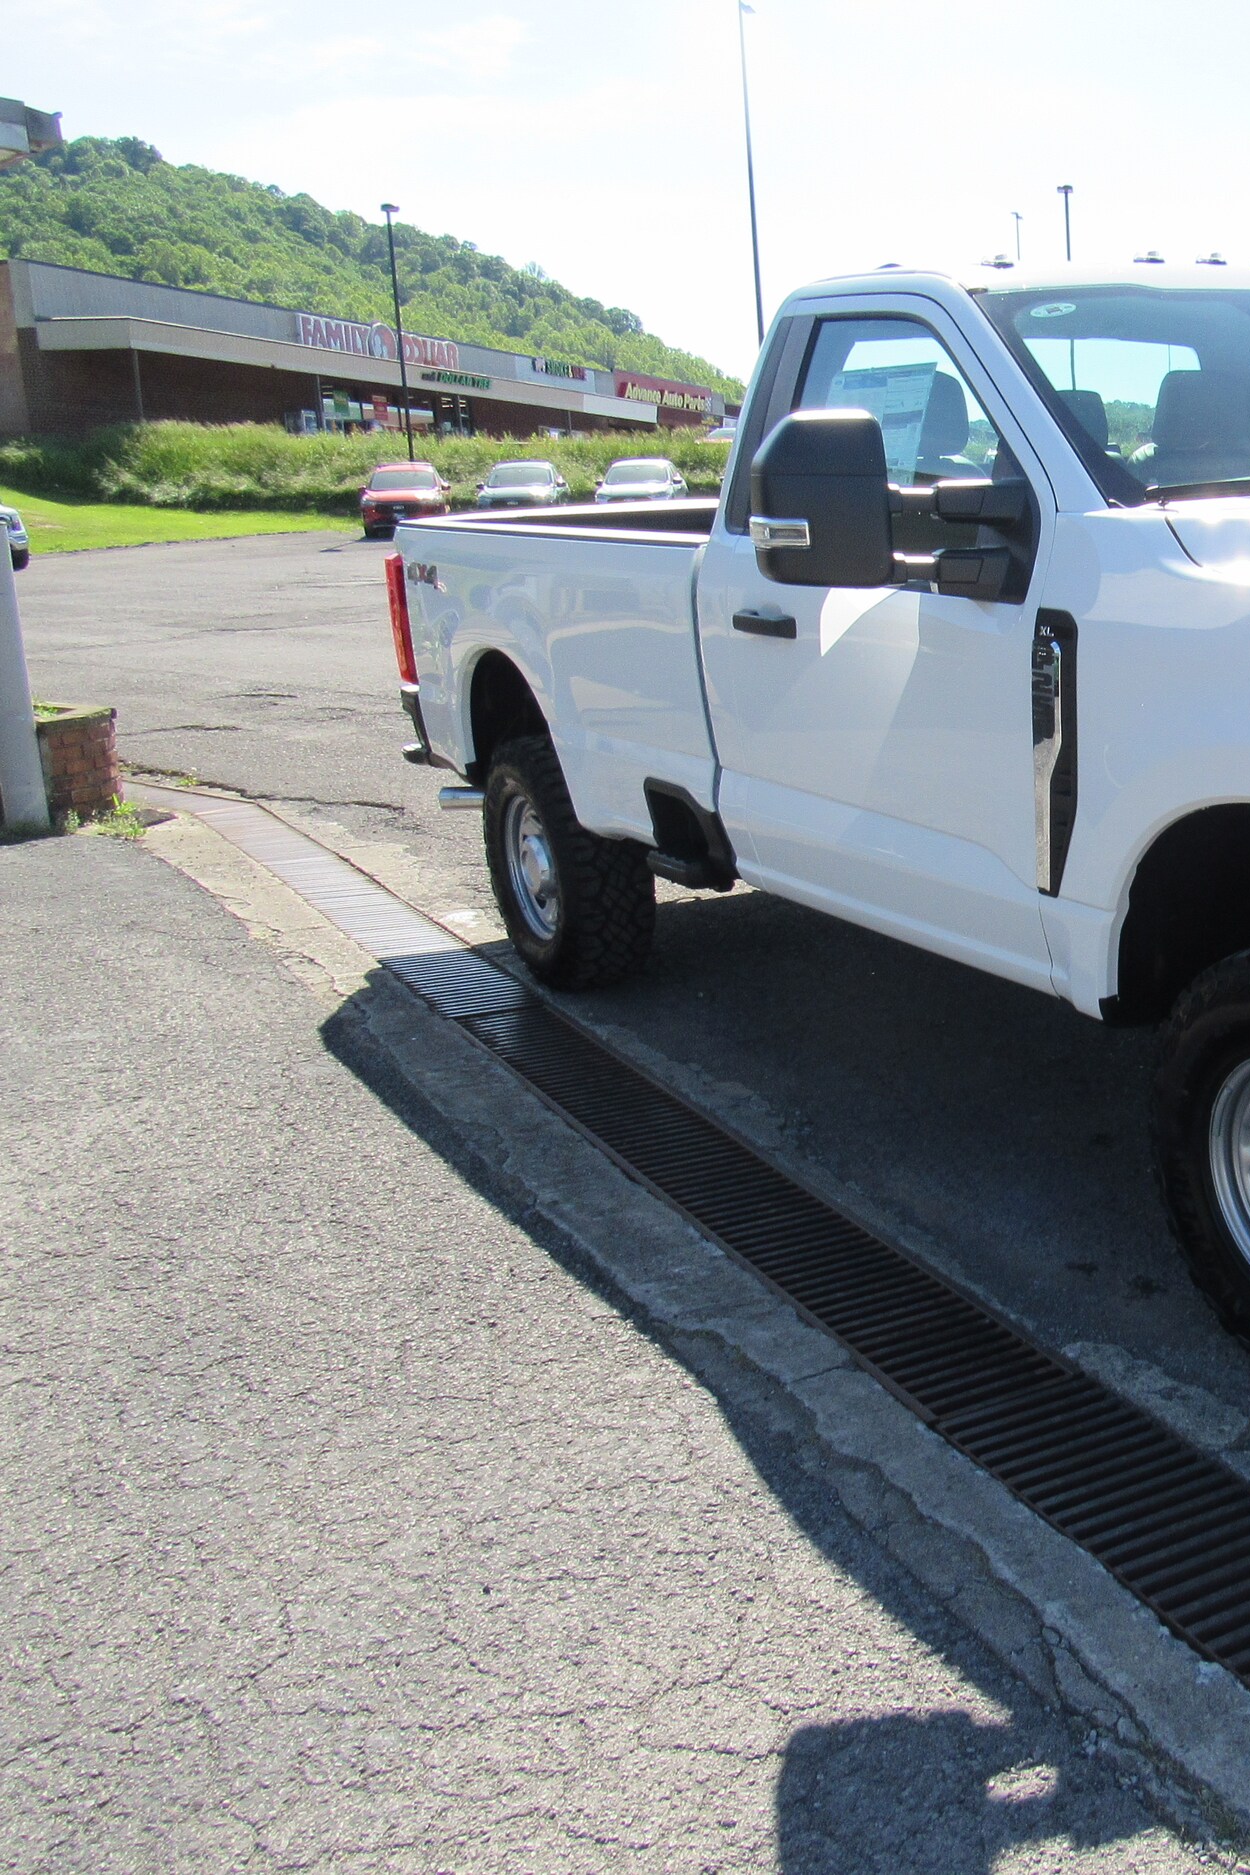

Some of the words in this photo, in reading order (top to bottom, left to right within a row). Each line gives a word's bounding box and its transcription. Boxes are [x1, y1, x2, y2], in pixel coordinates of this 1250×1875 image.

[300, 313, 370, 356] FAMILY
[397, 331, 460, 371] DOLLAR
[624, 382, 662, 404] Advance
[662, 390, 684, 407] Auto
[683, 393, 705, 412] Parts
[1039, 625, 1054, 638] XL
